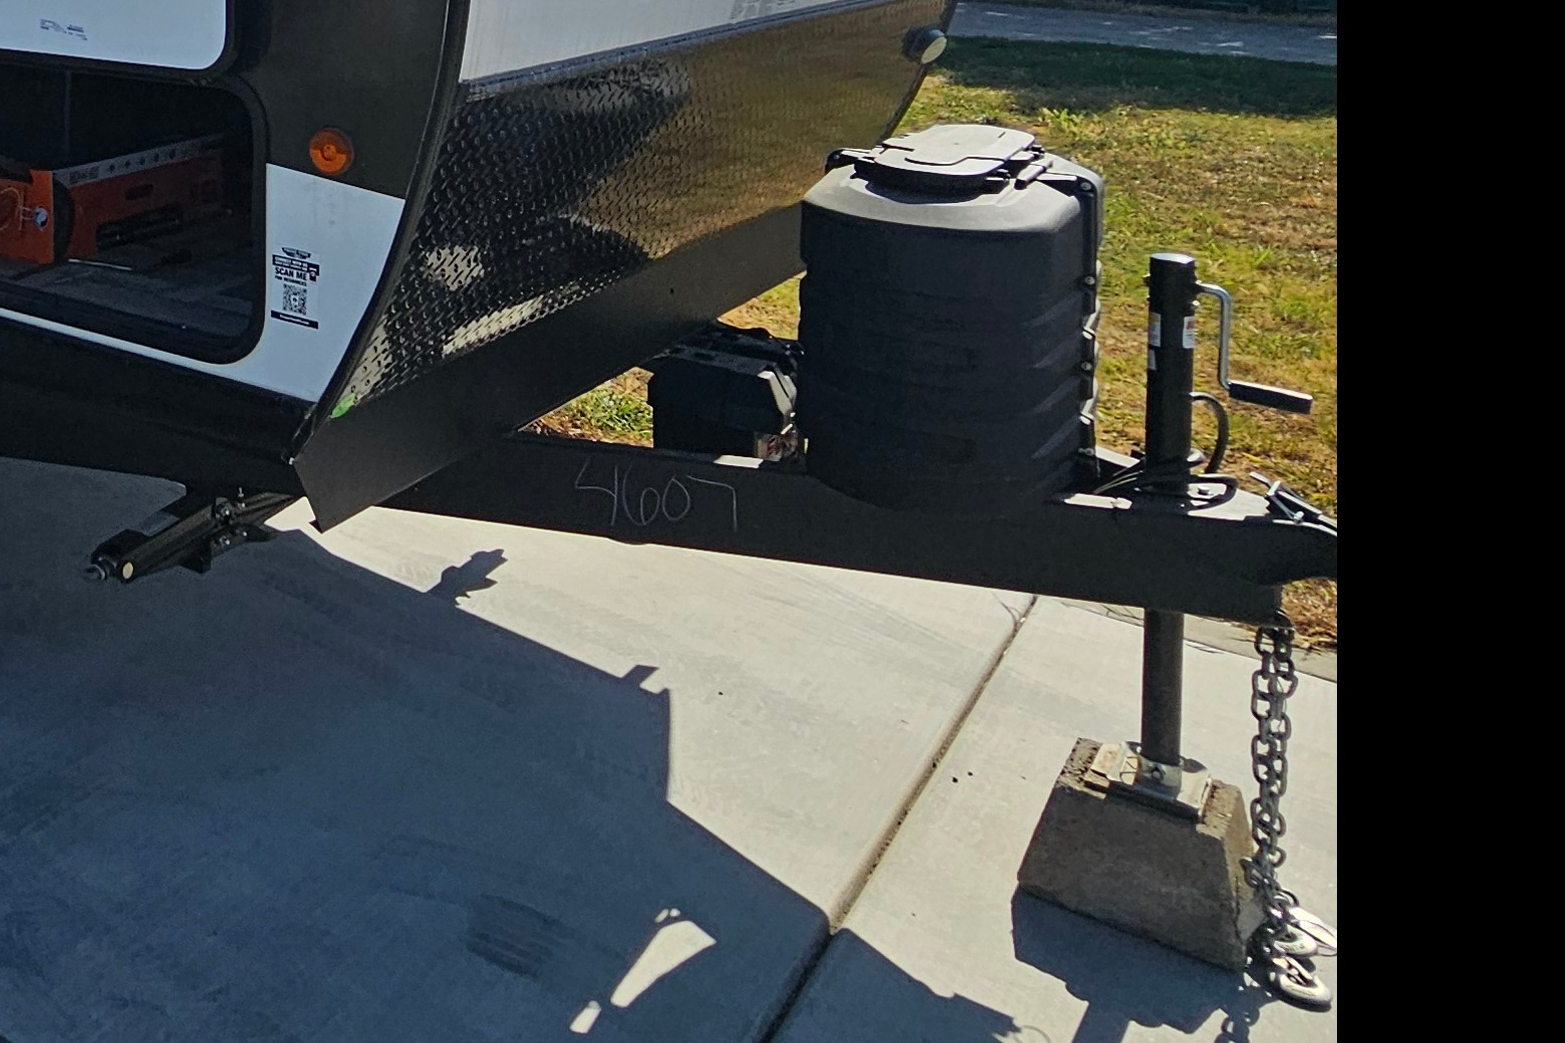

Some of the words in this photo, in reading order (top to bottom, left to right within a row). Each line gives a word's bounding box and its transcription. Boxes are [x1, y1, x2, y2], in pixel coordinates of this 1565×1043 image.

[275, 266, 294, 278] SCAN
[295, 270, 307, 282] ME
[574, 457, 738, 532] 4607
